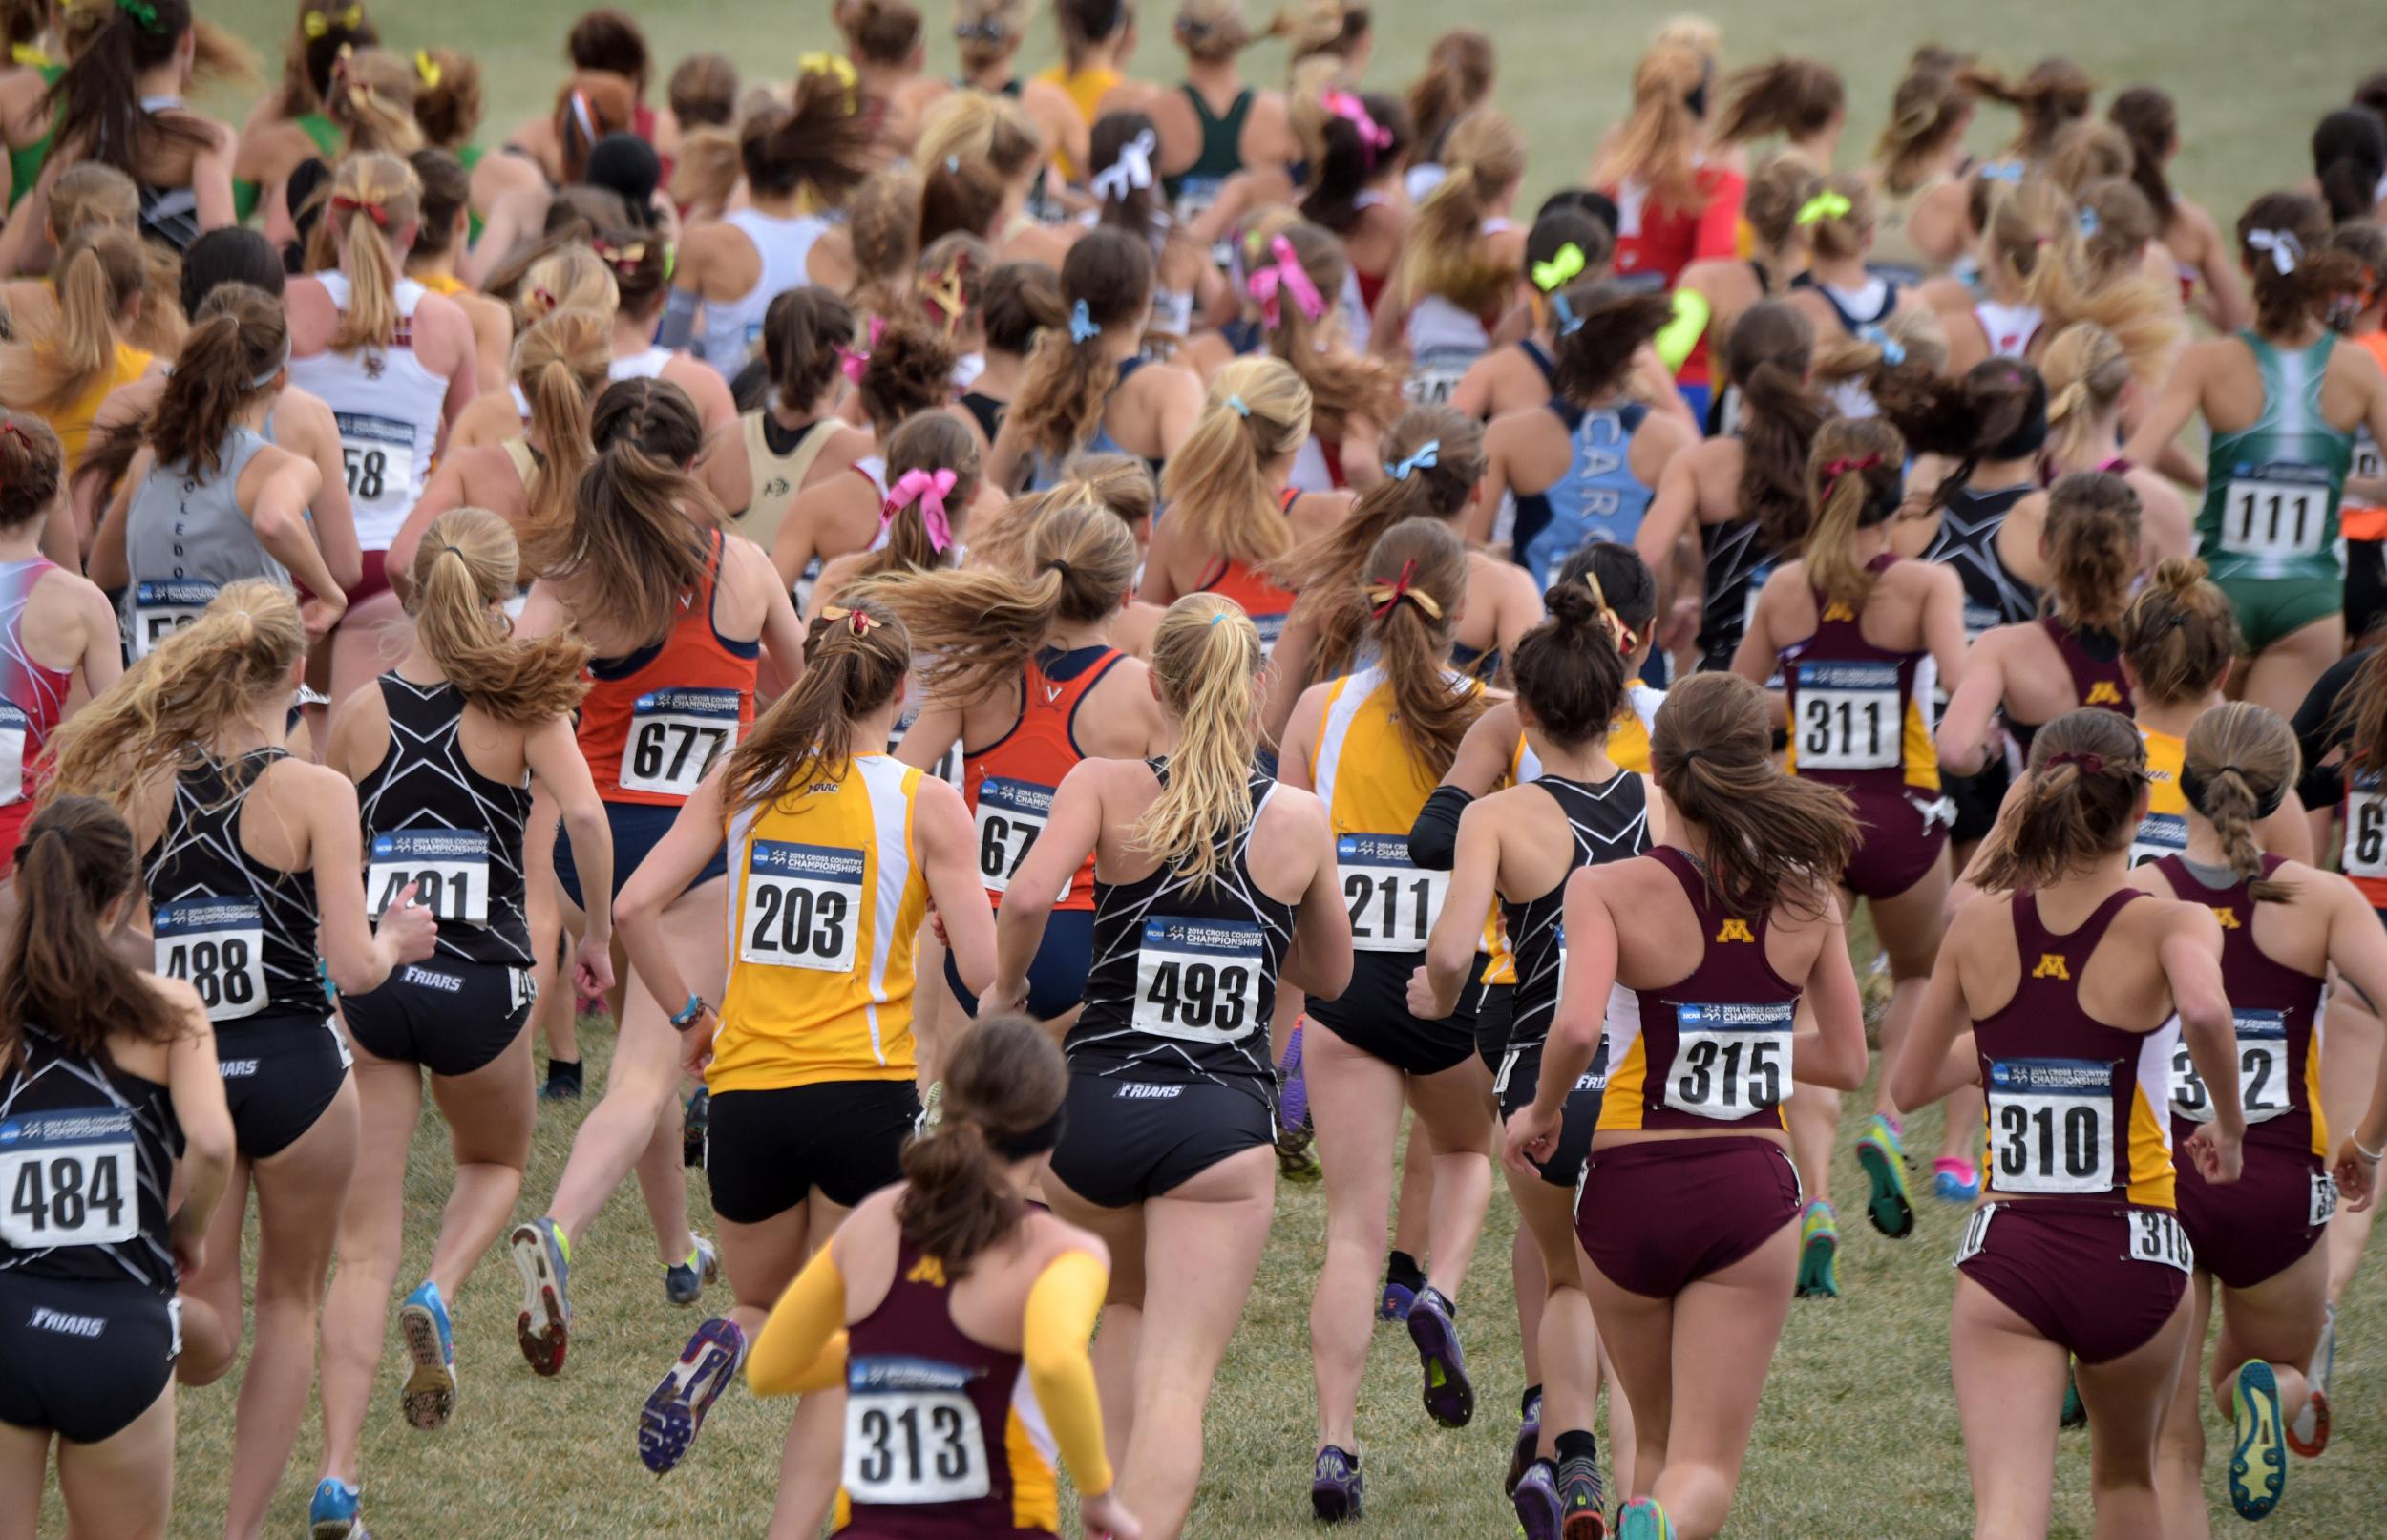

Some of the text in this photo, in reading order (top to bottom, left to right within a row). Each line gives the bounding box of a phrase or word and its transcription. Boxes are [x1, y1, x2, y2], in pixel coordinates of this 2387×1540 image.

[344, 449, 386, 501] 58
[174, 480, 195, 580] OLEDO
[2242, 494, 2308, 545] 111
[672, 701, 739, 711] CHAMPIONSHIPS
[1046, 686, 1062, 702] V
[1807, 700, 1880, 755] 311
[633, 723, 729, 785] 677
[413, 844, 488, 854] CHAMPIONSHIPS
[806, 854, 829, 863] CROSS
[981, 816, 1041, 879] 67
[1376, 849, 1408, 857] CHAMP
[2357, 803, 2384, 864] 6
[788, 858, 863, 874] CHAMPIONSHIPS
[378, 870, 468, 920] 491
[1345, 874, 1429, 939] 211
[752, 884, 847, 958] 203
[1187, 927, 1204, 936] 2014
[1187, 935, 1263, 946] CHAMPIONSHIPS
[1716, 918, 1755, 943] M
[167, 939, 253, 1008] 488
[405, 967, 462, 992] FRIARS
[2032, 954, 2070, 980] M
[1147, 961, 1249, 1031] 493
[1723, 1012, 1792, 1021] CHAMPIONSHIPS
[219, 1060, 258, 1078] IARS
[1119, 1085, 1183, 1098] FRIARS
[1679, 1040, 1780, 1110] 315
[2031, 1075, 2110, 1086] CHAMPIONSHIPS
[2173, 1048, 2274, 1110] 32
[2001, 1104, 2099, 1178] 310
[11, 1155, 123, 1232] 484
[2141, 1212, 2188, 1267] 310
[32, 1309, 104, 1337] FRIARS
[861, 1406, 969, 1484] 313
